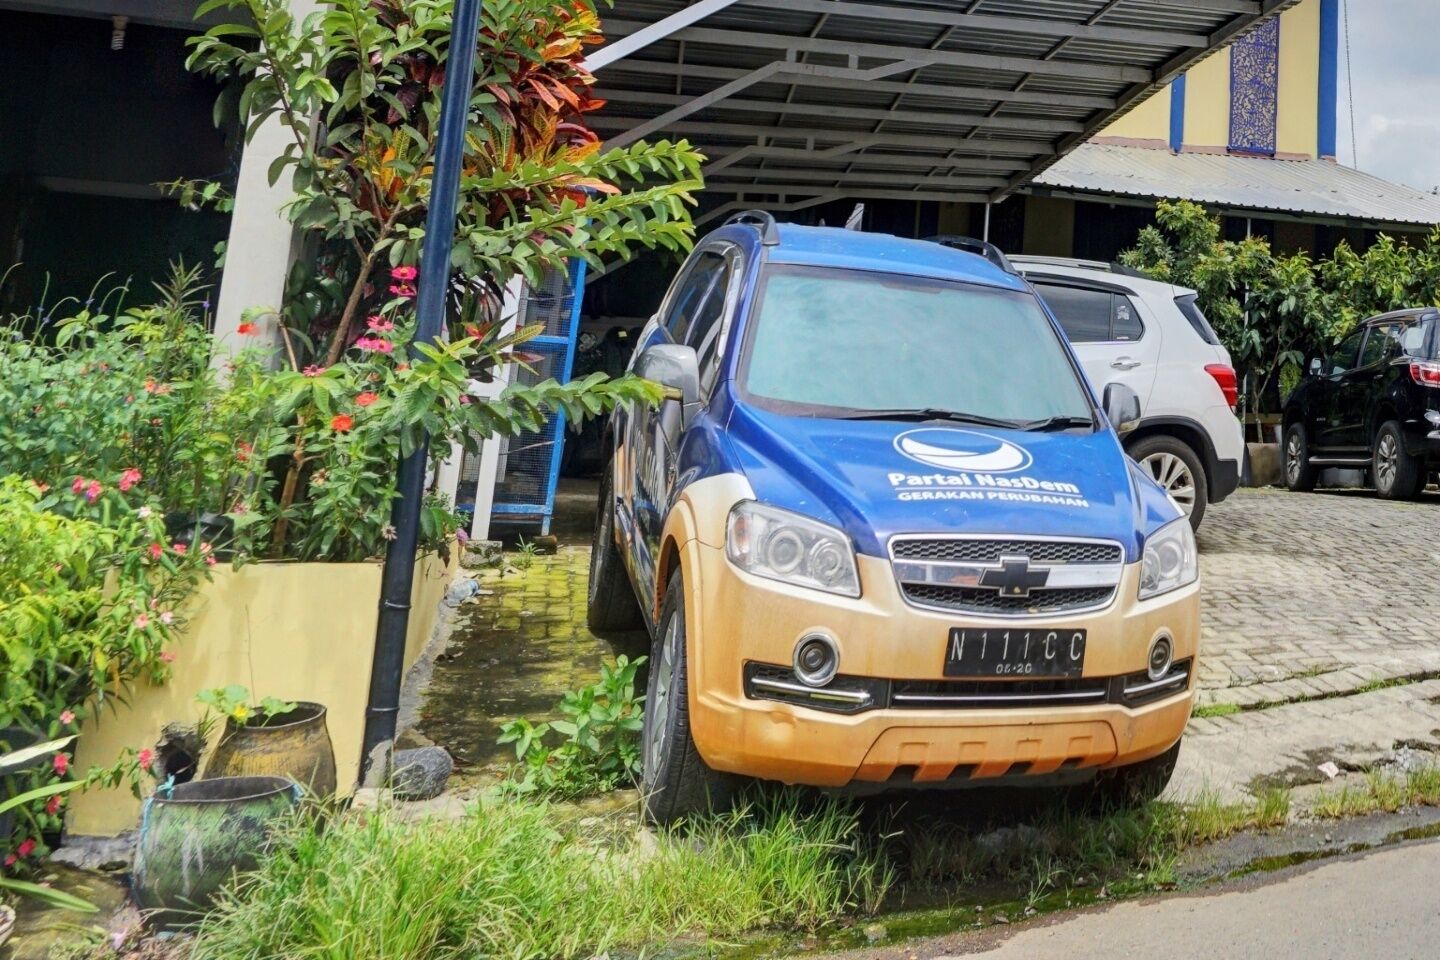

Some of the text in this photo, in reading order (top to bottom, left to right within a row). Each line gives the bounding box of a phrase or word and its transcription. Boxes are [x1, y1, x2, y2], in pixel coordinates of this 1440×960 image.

[887, 473, 1080, 494] Partai NasDem
[898, 492, 1090, 508] GERAKAN PERUBAHAN
[951, 632, 965, 661] N
